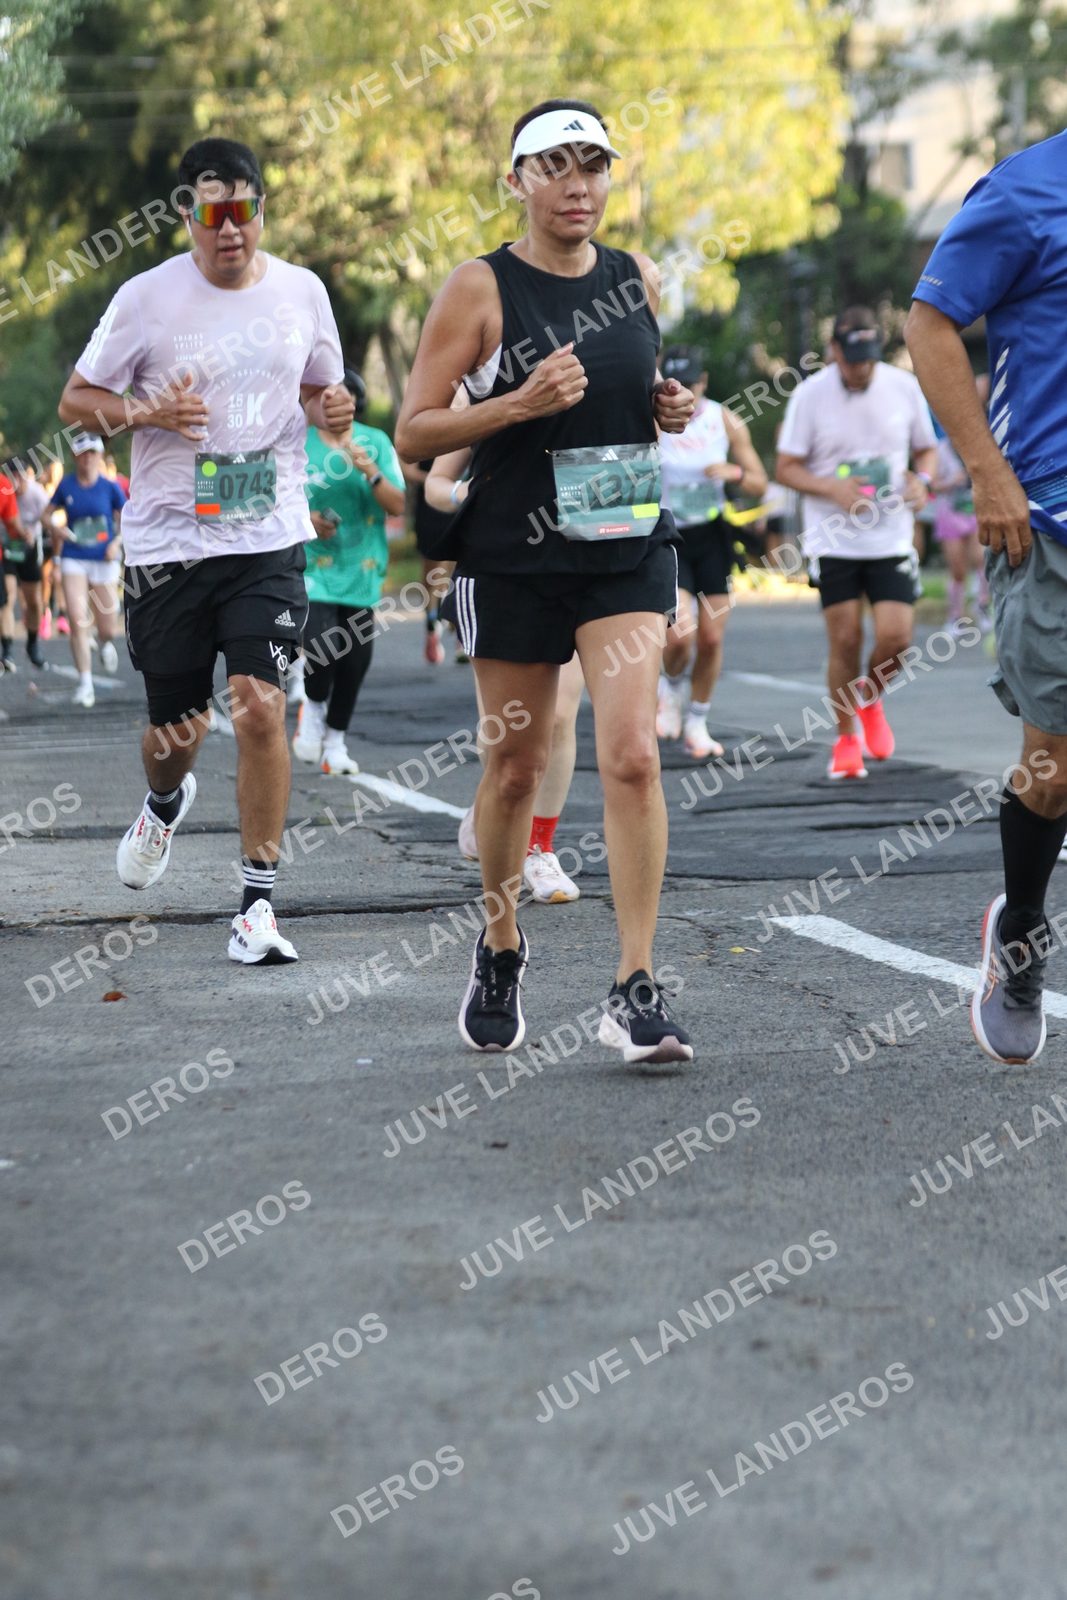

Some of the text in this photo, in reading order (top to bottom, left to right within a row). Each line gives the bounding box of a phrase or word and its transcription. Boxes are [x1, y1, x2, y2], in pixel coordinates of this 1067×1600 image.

[226, 413, 243, 429] 30
[246, 391, 268, 426] K
[218, 469, 275, 501] 0743
